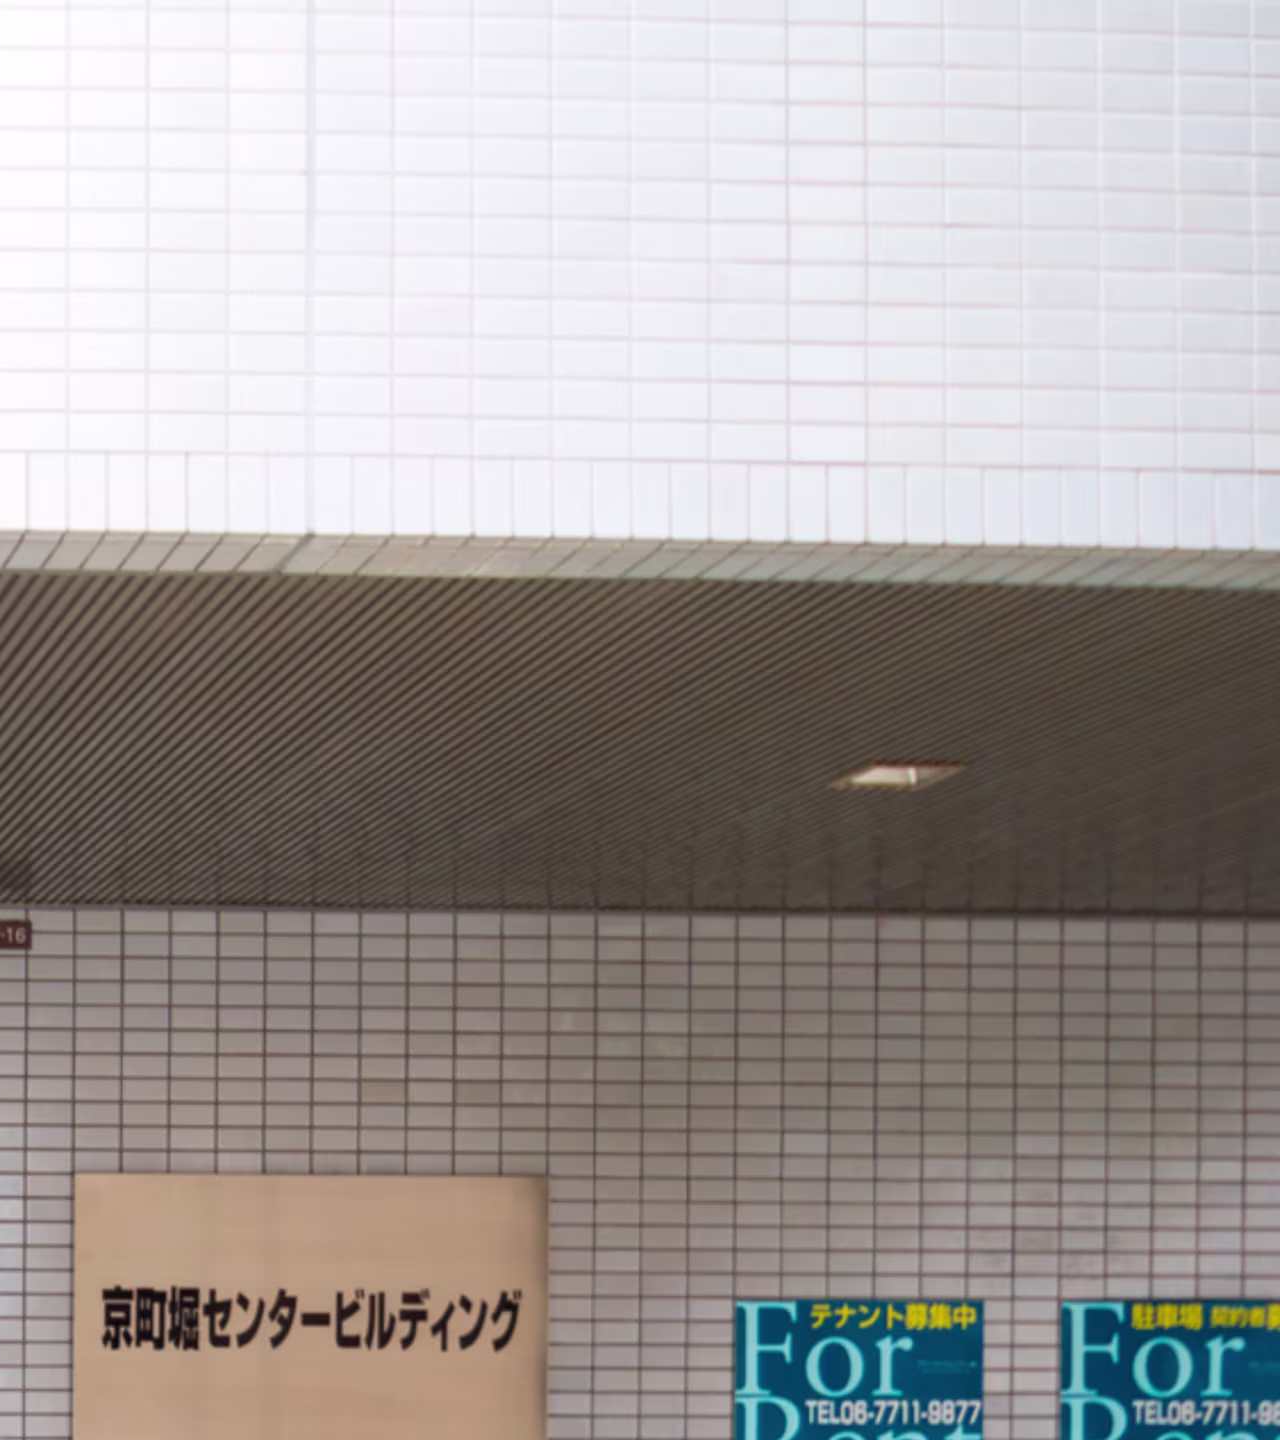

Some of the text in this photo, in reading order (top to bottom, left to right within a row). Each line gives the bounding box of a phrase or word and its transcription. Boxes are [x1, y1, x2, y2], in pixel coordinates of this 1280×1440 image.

[101, 1286, 521, 1352] 京町堀センタービルディング
[735, 1301, 913, 1397] For
[810, 1304, 977, 1331] テナント募集中
[1062, 1301, 1245, 1397] For
[1131, 1304, 1202, 1331] 駐車場
